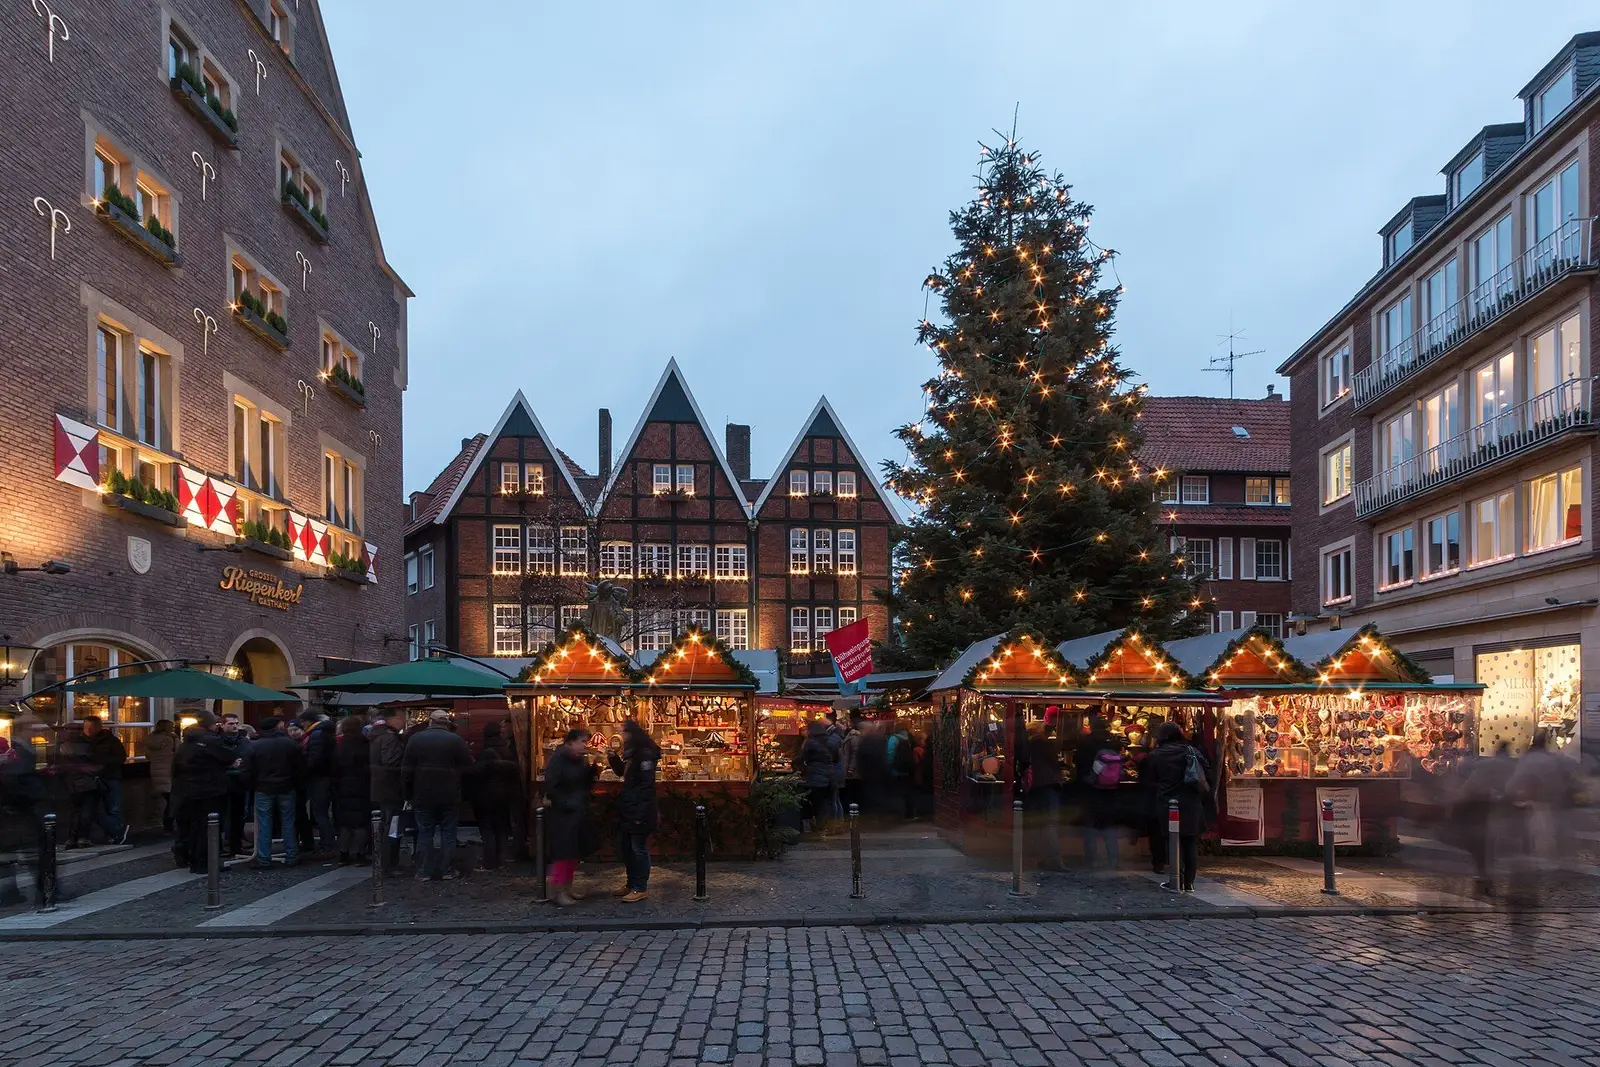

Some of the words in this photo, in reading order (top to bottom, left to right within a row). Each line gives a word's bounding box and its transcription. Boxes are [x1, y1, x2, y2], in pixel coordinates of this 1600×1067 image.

[249, 569, 278, 582] GROSSER
[220, 566, 303, 604] Riepenkerl
[258, 596, 290, 610] GASTHAUS
[1503, 677, 1543, 689] MERRY
